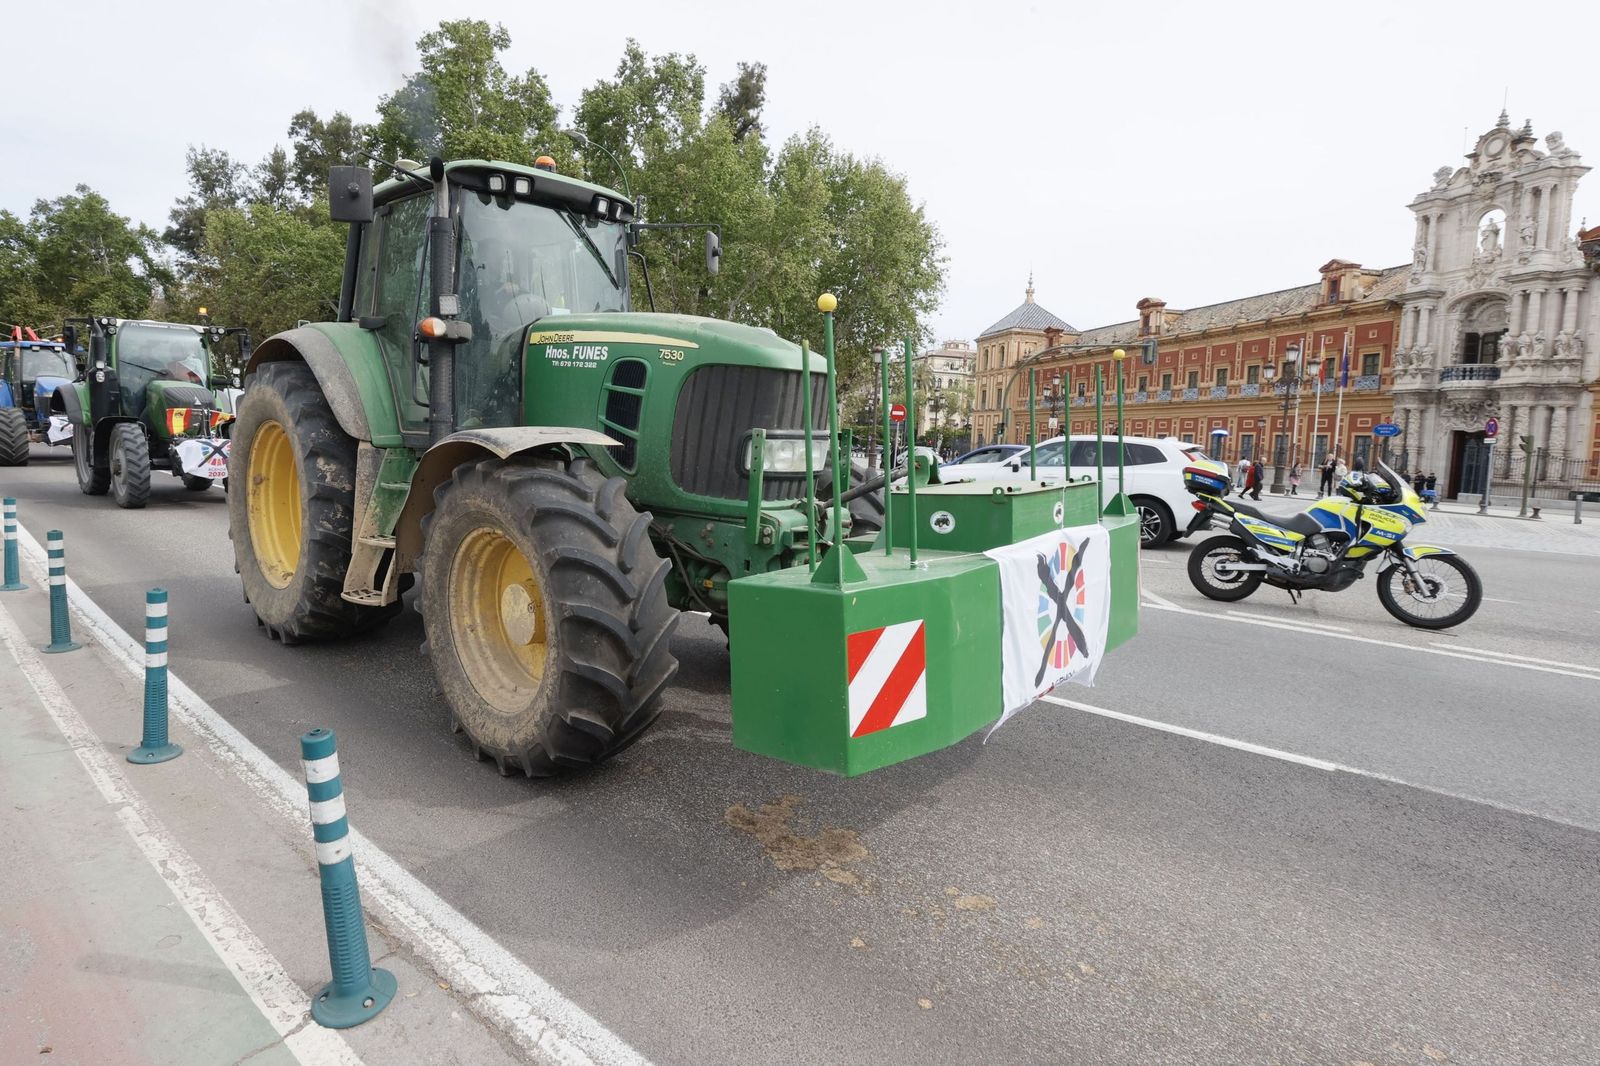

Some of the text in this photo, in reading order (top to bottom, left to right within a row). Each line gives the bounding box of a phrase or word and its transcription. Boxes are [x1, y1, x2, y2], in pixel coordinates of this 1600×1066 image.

[537, 333, 575, 343] JOHN DEERE
[545, 345, 609, 360] Hnos. FUNES
[658, 348, 684, 361] 7530
